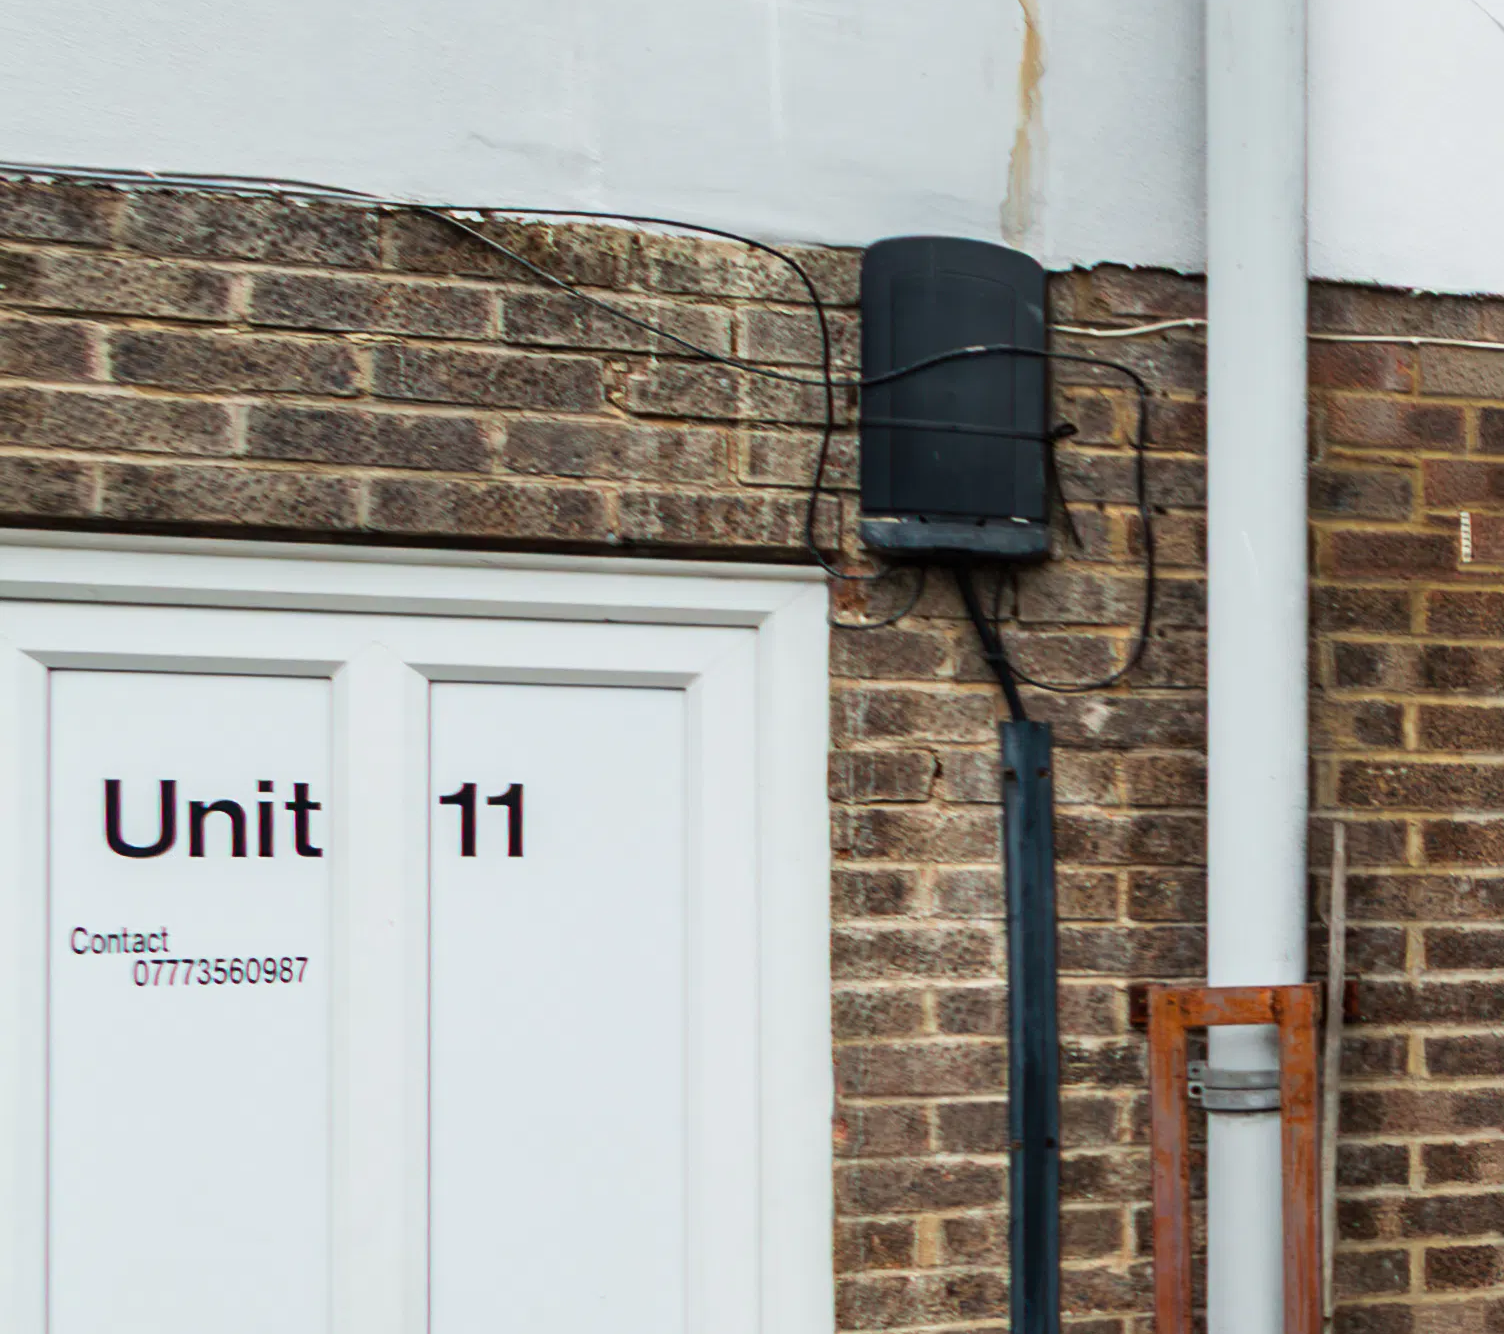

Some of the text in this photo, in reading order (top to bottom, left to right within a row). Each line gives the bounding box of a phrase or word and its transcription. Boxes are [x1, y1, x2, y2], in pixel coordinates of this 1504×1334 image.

[103, 778, 525, 859] Unit 11
[70, 926, 171, 955] Contact
[132, 956, 310, 986] 07773560987
